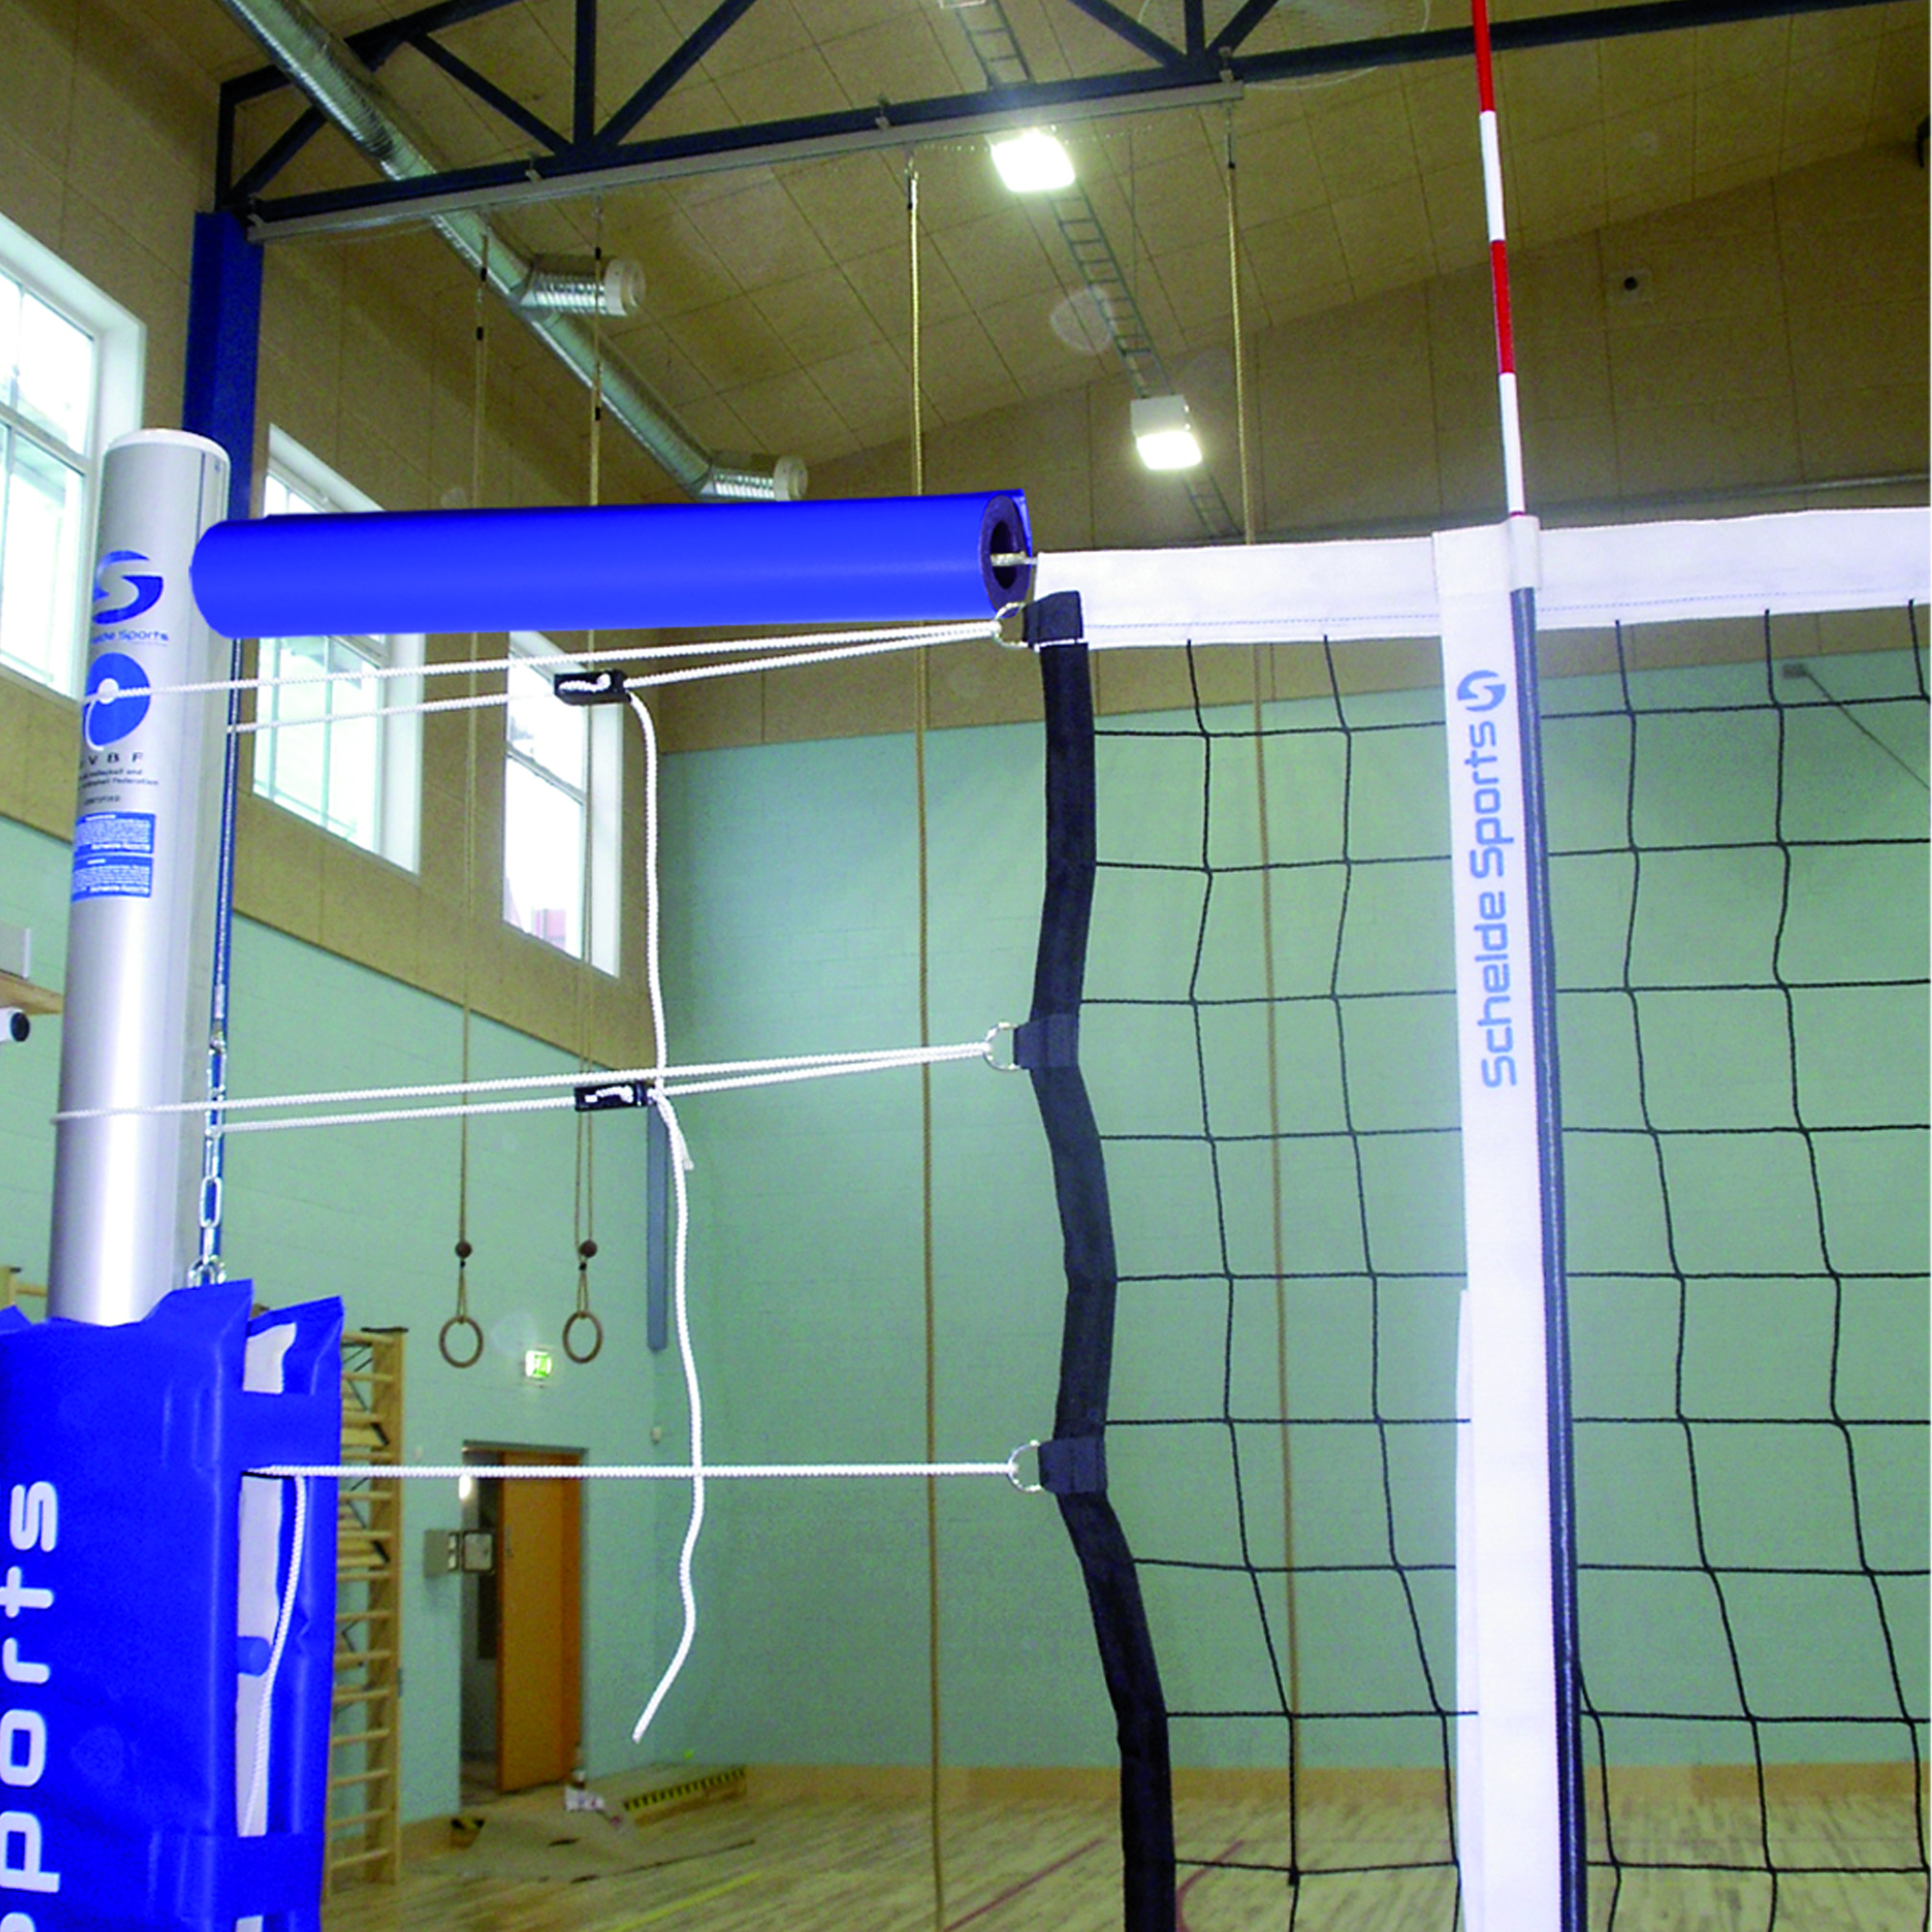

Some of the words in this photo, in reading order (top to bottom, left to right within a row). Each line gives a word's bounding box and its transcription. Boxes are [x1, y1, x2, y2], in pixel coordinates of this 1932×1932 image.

[118, 629, 169, 642] Sports
[1463, 720, 1514, 879] Sports
[1473, 890, 1517, 1088] Schelde
